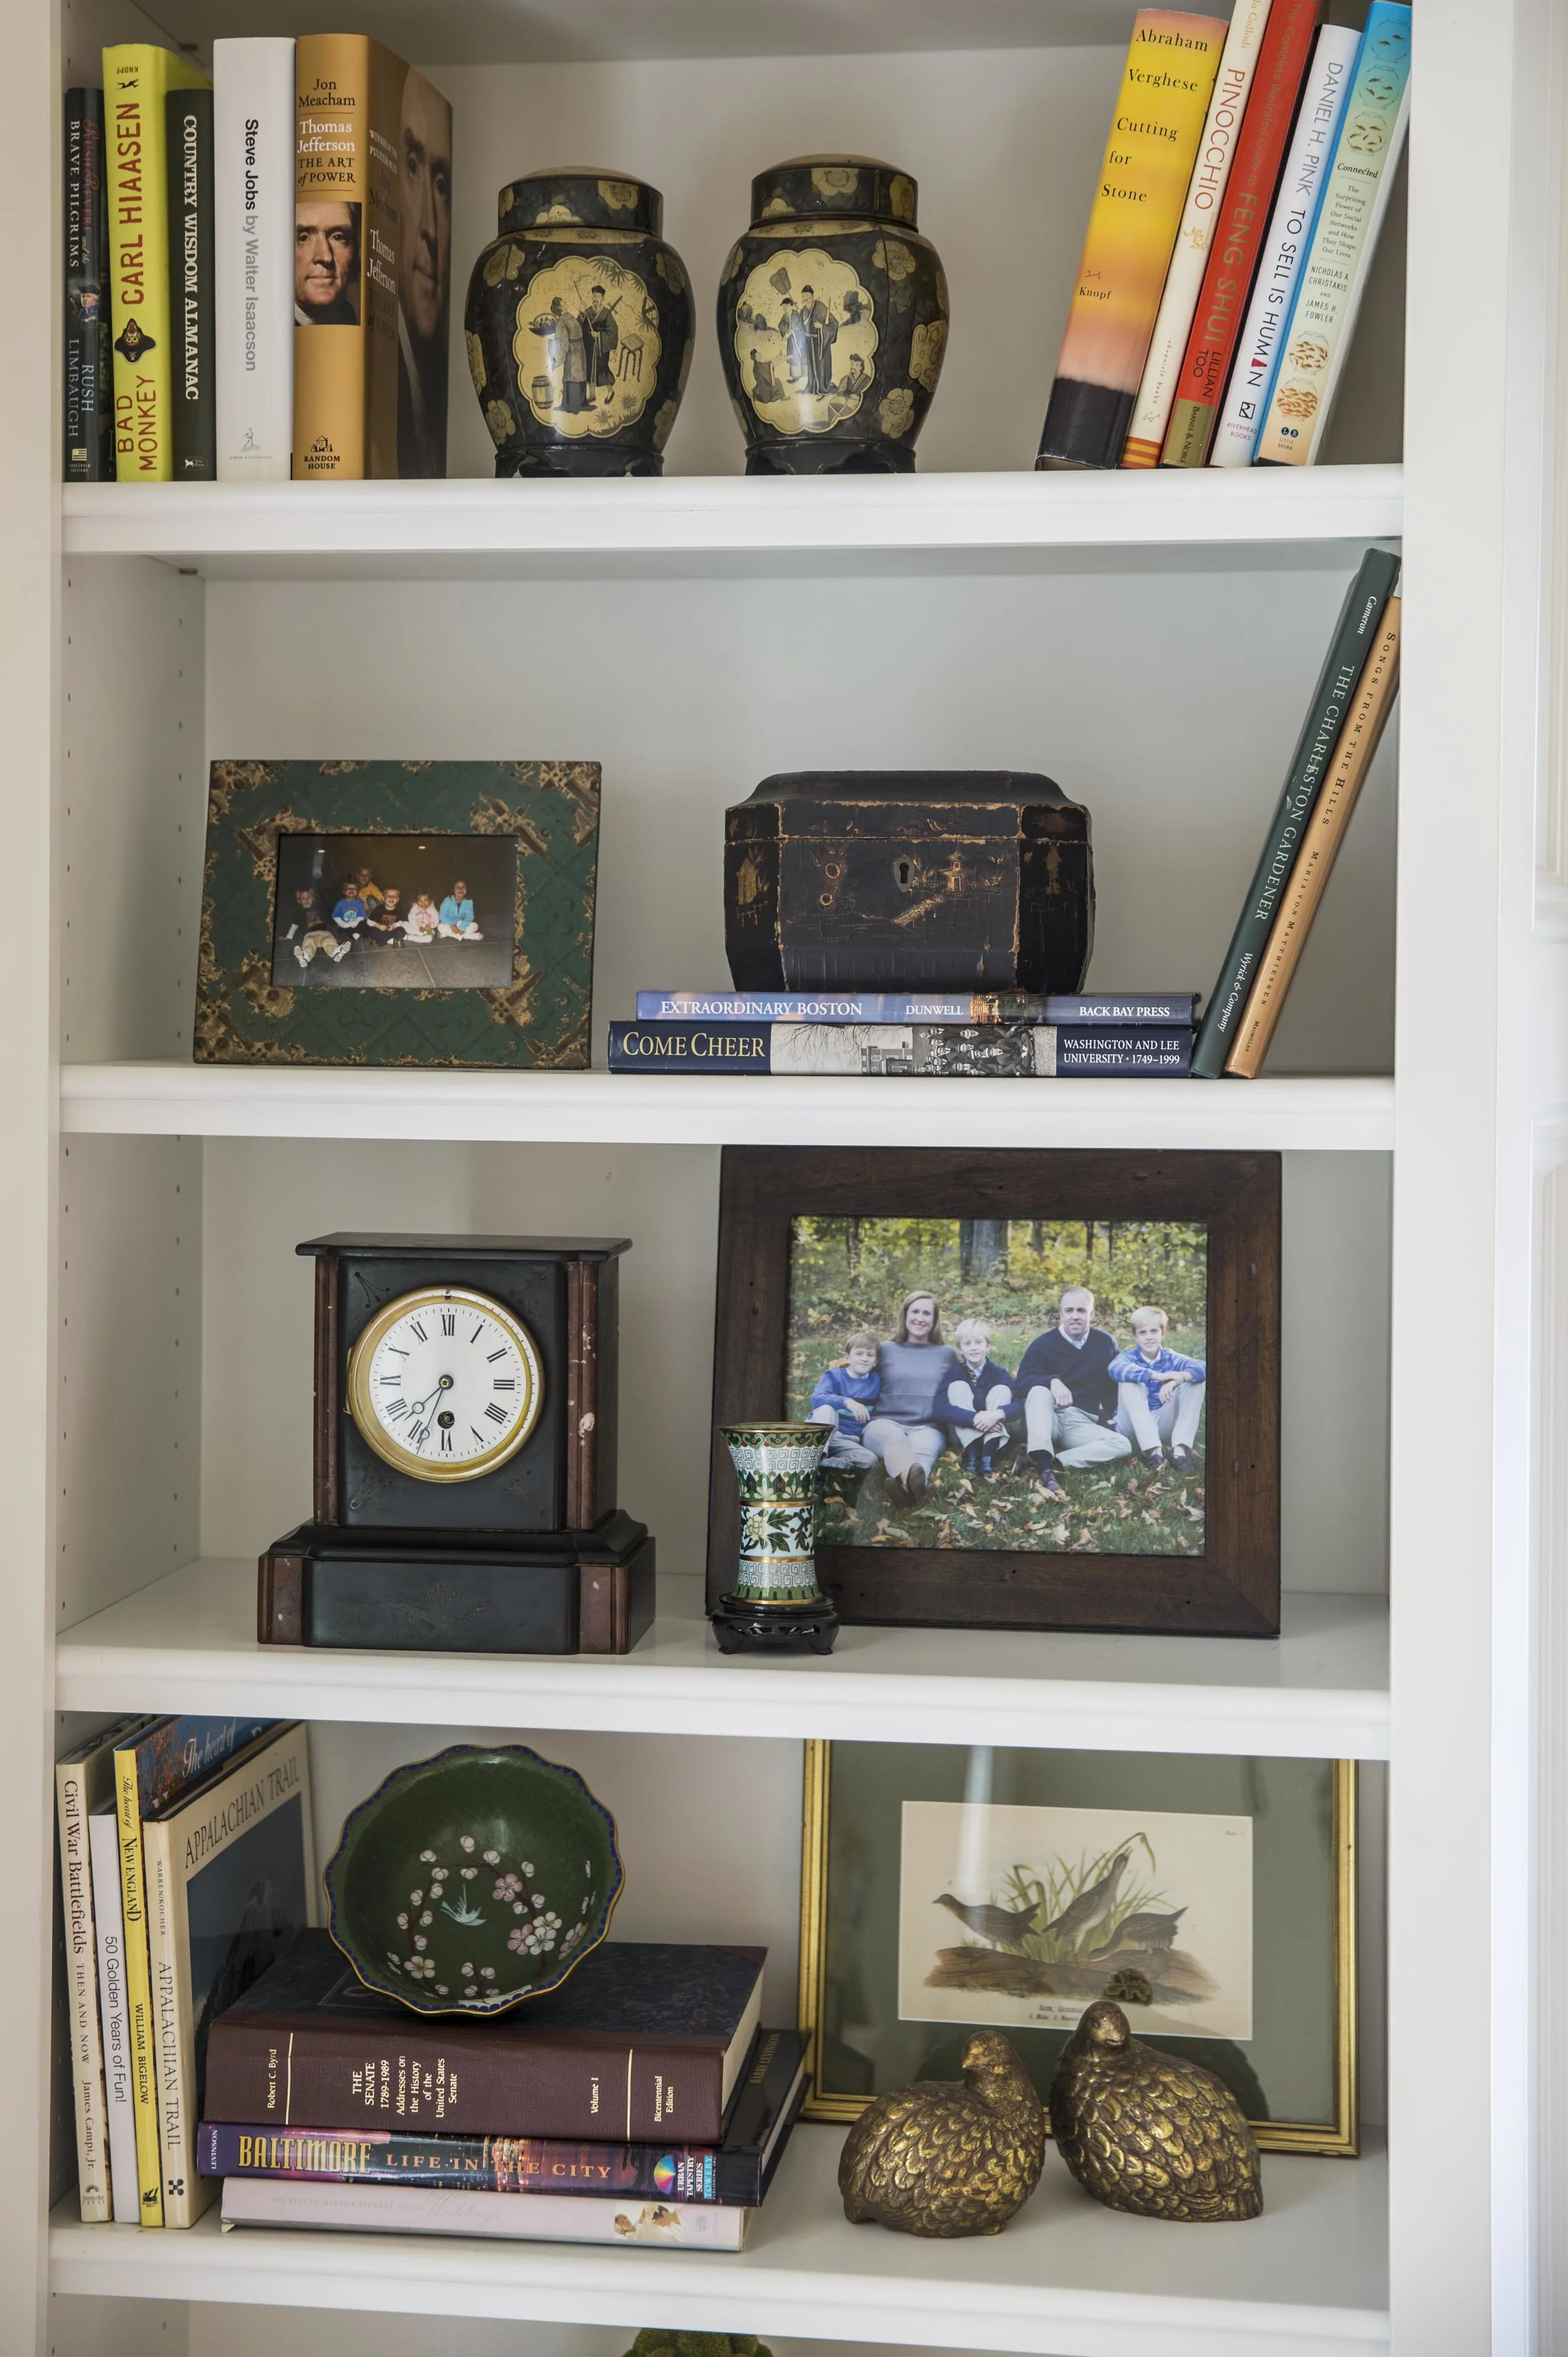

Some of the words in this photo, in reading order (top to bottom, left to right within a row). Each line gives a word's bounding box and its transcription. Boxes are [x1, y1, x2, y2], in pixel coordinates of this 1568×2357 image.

[1287, 3, 1301, 23] The
[1136, 29, 1208, 51] Abraham
[1241, 12, 1258, 49] Collodi
[1273, 26, 1295, 80] Complete
[116, 66, 139, 74] KNOPF
[314, 78, 337, 90] Jon
[1129, 68, 1198, 92] Verghese
[299, 92, 356, 107] Meacham
[1314, 61, 1343, 124] DANIEL
[1259, 82, 1282, 136] Illustrated
[300, 119, 352, 134] Thomas
[1117, 117, 1179, 142] Cutting
[1195, 68, 1246, 209] PINOCCHIO
[1308, 129, 1326, 147] H.
[70, 120, 80, 176] BRAVE
[245, 119, 259, 166] Steve
[297, 137, 356, 153] Jefferson
[1109, 151, 1132, 165] for
[1251, 137, 1268, 171] Guide
[116, 103, 143, 224] HIAASEN
[184, 115, 198, 208] COUNTRY
[299, 158, 323, 168] THE
[327, 157, 354, 167] ART
[1296, 153, 1320, 196] PINK
[1337, 162, 1379, 178] Connected
[245, 170, 259, 210] Jobs
[299, 172, 307, 187] of
[310, 172, 356, 183] POWER
[1101, 183, 1147, 202] Stone
[1247, 175, 1258, 186] to
[1335, 193, 1366, 206] Surprising
[1335, 202, 1353, 211] Power
[70, 183, 79, 267] PILGRIMS
[242, 215, 259, 235] by
[1223, 191, 1259, 267] FENG
[1287, 210, 1306, 235] TO
[1330, 220, 1357, 231] Networks
[1344, 213, 1362, 223] Social
[184, 212, 198, 293] WISDOM
[370, 228, 395, 264] Thomas
[1322, 237, 1337, 246] They
[1338, 240, 1356, 251] Shape
[1336, 249, 1351, 258] Lives
[120, 234, 144, 305] CARL
[245, 238, 259, 292] Walter
[1274, 242, 1296, 278] SELL
[1311, 266, 1343, 278] NICHOLAS
[367, 258, 396, 294] Jefferson
[1308, 277, 1347, 292] CHRISTAKIS
[1079, 287, 1112, 300] Knopf
[1268, 287, 1285, 304] IS
[1305, 300, 1328, 310] JAMES
[1331, 305, 1338, 313] H.
[1204, 278, 1237, 343] SHUI
[1305, 310, 1333, 323] FOWLER
[185, 297, 199, 400] ALMANAC
[245, 297, 259, 371] Isaacson
[1193, 349, 1209, 378] TOO
[1202, 351, 1222, 398] LILLIAN
[68, 339, 79, 437] LIMBAUGH
[82, 364, 94, 411] RUSH
[117, 395, 134, 453] BAD
[136, 375, 158, 470] MONKEY
[1187, 406, 1200, 433] BARNES
[1227, 421, 1258, 435] RIVERHEAD
[1230, 432, 1251, 440] BOOKS
[1180, 442, 1192, 464] NOBLE
[1358, 596, 1377, 635] Cameron
[1371, 630, 1396, 684] SONGS
[1332, 665, 1355, 700] THE
[1353, 689, 1374, 734] FROM
[1290, 706, 1340, 822] CHARLESTON
[1342, 737, 1357, 770] THE
[1322, 777, 1346, 825] HILLS
[1255, 826, 1296, 920] GARDENER
[1301, 851, 1318, 889] MARIA
[1292, 894, 1303, 916] VON
[1236, 952, 1253, 982] Wyrick
[1261, 921, 1295, 1005] MATTHIESSEN
[1233, 982, 1242, 991] &
[662, 1001, 793, 1015] EXTRAORDINARY
[797, 1002, 862, 1016] BOSTON
[906, 1005, 963, 1015] DUNWELL
[1079, 1006, 1112, 1017] BACK
[1113, 1006, 1136, 1017] BAY
[1136, 1007, 1170, 1017] PRESS
[1219, 991, 1239, 1032] Company
[623, 1032, 687, 1057] COME
[691, 1032, 766, 1057] CHEER
[1064, 1039, 1133, 1051] WASHINGTON
[1135, 1040, 1156, 1051] AND
[1159, 1040, 1179, 1051] LEE
[1245, 1020, 1259, 1052] MACMILLAN
[1064, 1053, 1124, 1064] UNIVERSITY
[1131, 1054, 1180, 1064] 1749–1999
[440, 1315, 455, 1337] XII
[183, 1737, 203, 1777] The
[64, 1779, 80, 1818] Civil
[123, 1776, 133, 1794] The
[124, 1796, 133, 1819] heart
[186, 1791, 266, 1869] APPALACHIAN
[267, 1756, 301, 1802] TRAIL
[66, 1822, 78, 1856] War
[122, 1818, 134, 1831] of
[122, 1837, 137, 1865] NEW
[68, 1861, 88, 1954] Battlefields
[125, 1867, 142, 1922] ENGLAND
[157, 1860, 166, 1937] WARREN/KOCHER
[105, 1936, 118, 1954] 50
[76, 1962, 85, 1997] THEN
[106, 1959, 119, 2008] Golden
[78, 2001, 88, 2029] AND
[135, 2003, 145, 2051] WILLIAM
[159, 1961, 178, 2091] APPALACHIAN
[110, 2012, 122, 2051] Years
[80, 2034, 90, 2065] NOW
[112, 2055, 124, 2069] of
[268, 2048, 277, 2069] Byrd
[399, 2055, 405, 2067] on
[138, 2055, 149, 2105] BIGELOW
[268, 2070, 277, 2080] C.
[352, 2071, 362, 2094] THE
[365, 2062, 375, 2105] SENATE
[381, 2060, 389, 2108] 1789-1989
[411, 2061, 421, 2094] History
[423, 2072, 432, 2087] the
[437, 2058, 445, 2084] States
[82, 2080, 91, 2113] James
[114, 2072, 127, 2104] Fun!
[267, 2082, 276, 2109] Robert
[396, 2070, 405, 2116] Addresses
[423, 2090, 432, 2100] of
[436, 2087, 445, 2117] United
[448, 2073, 457, 2104] Senate
[590, 2085, 599, 2114] Volume
[654, 2075, 662, 2122] Bicentennial
[410, 2097, 419, 2113] the
[84, 2117, 96, 2156] Campi,
[166, 2097, 181, 2151] TRAIL
[86, 2156, 96, 2171] Jr.
[238, 2135, 371, 2174] BALTIMORE
[386, 2154, 440, 2169] LIFE
[453, 2157, 479, 2171] IN
[492, 2156, 540, 2175] THE
[552, 2163, 612, 2180] CITY
[704, 2156, 712, 2198] TOWERY
